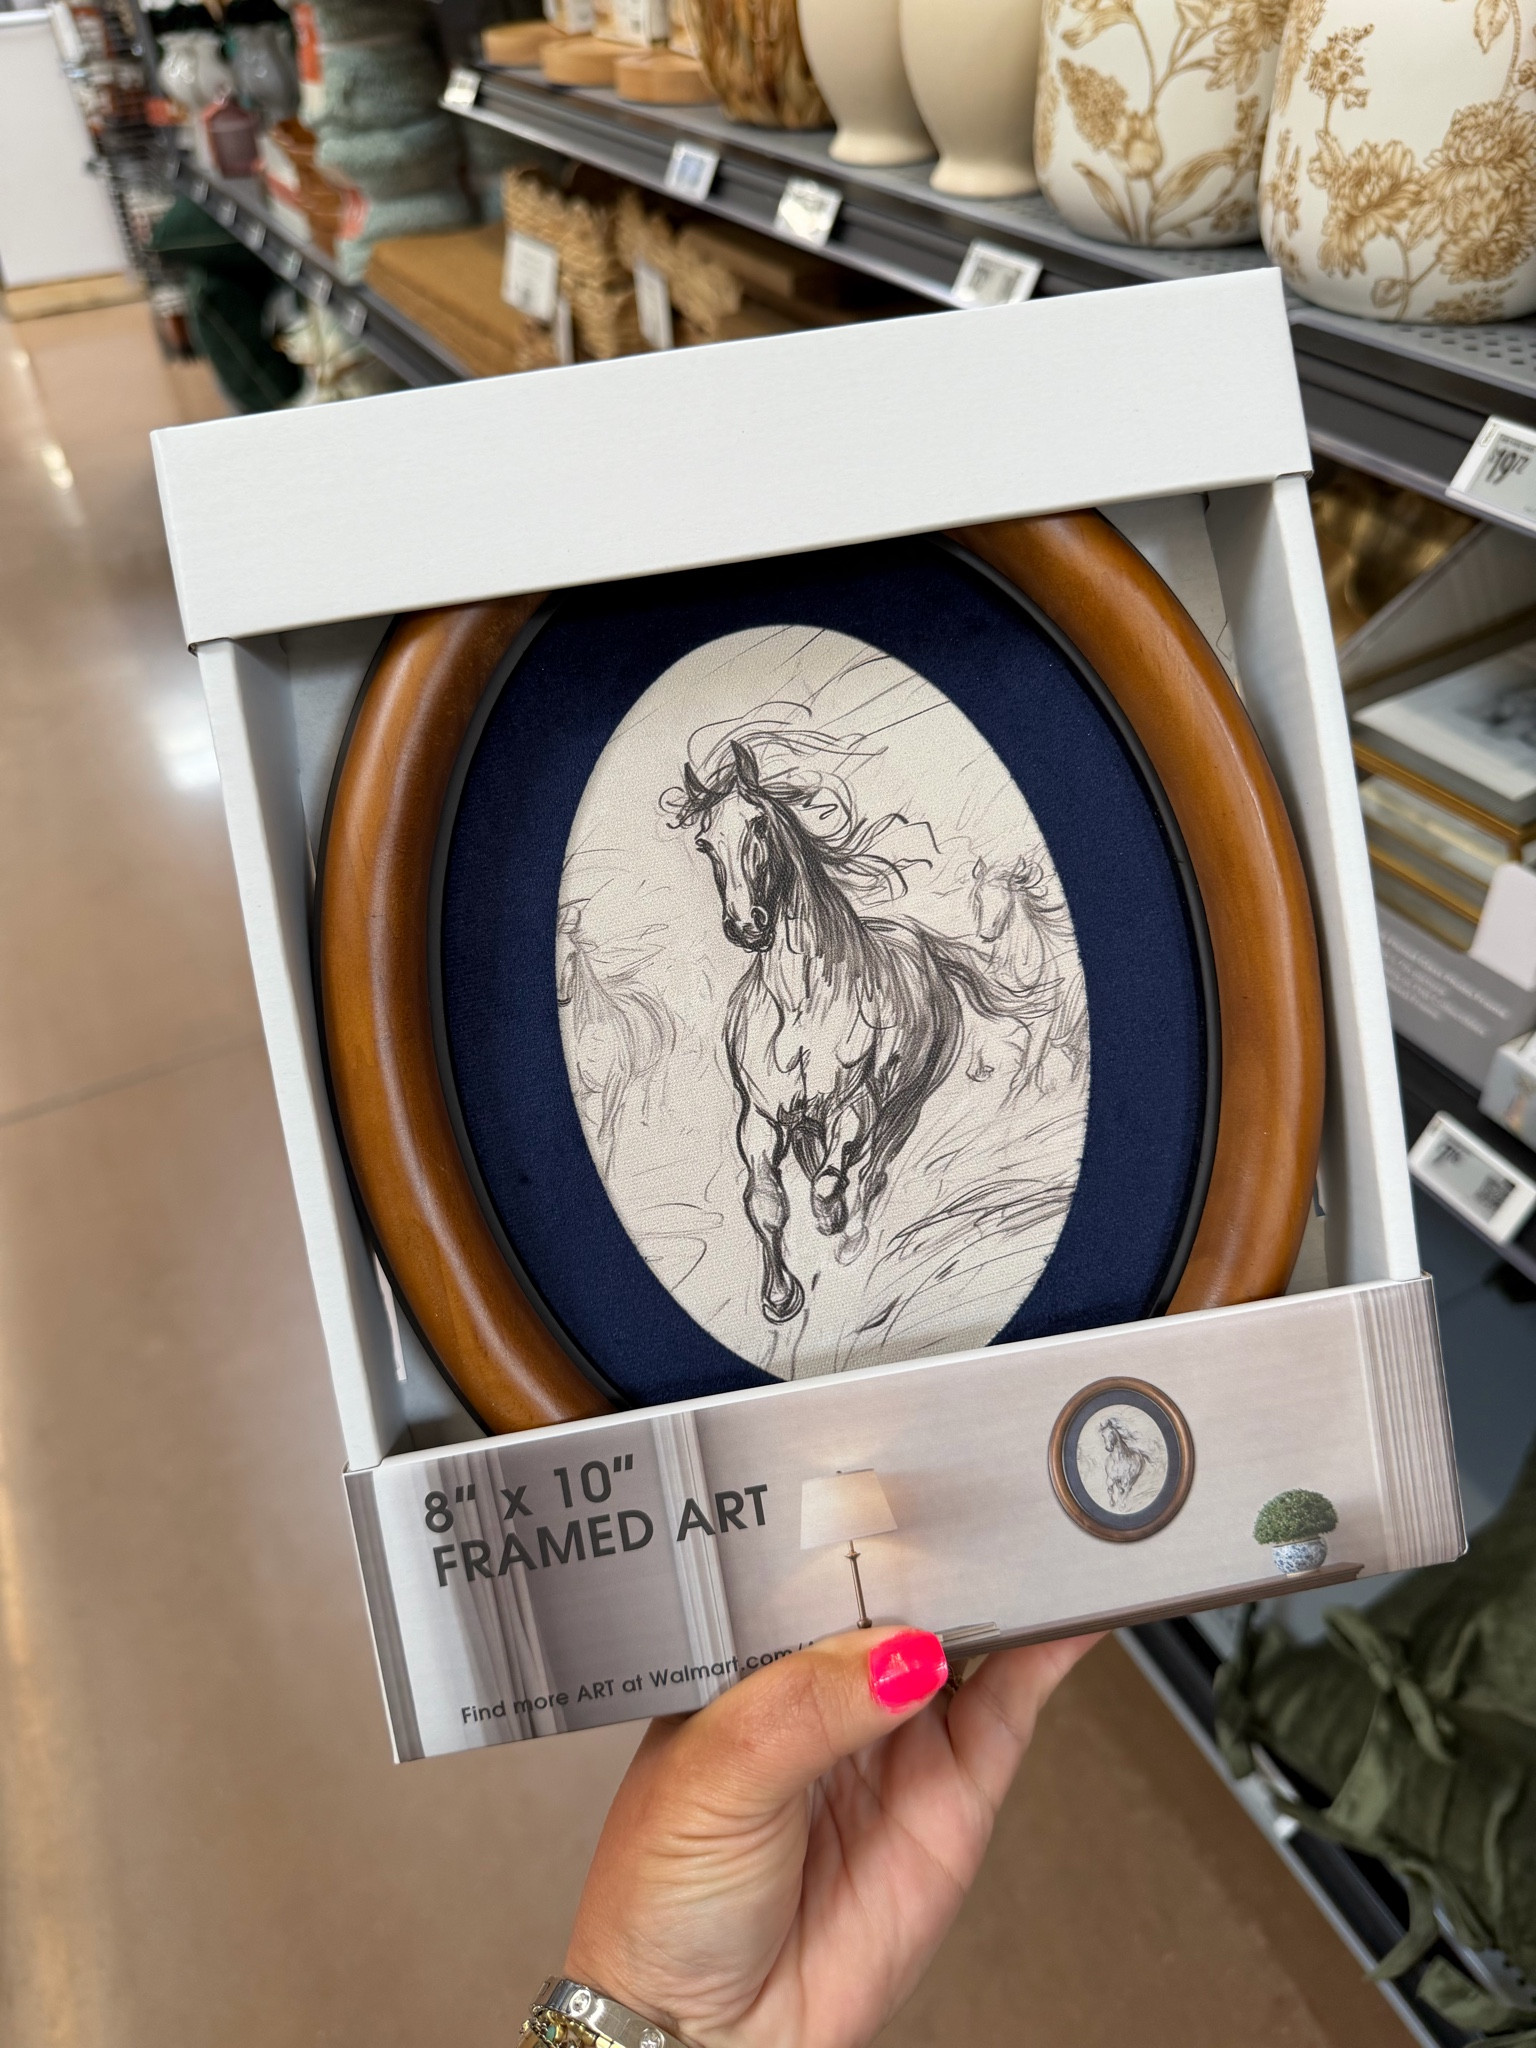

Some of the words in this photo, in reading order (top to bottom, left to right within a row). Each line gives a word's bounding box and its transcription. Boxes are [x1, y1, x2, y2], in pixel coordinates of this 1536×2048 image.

[425, 1483, 476, 1533] 8"
[500, 1485, 534, 1520] x
[553, 1453, 634, 1508] 10"
[432, 1509, 654, 1587] FRAMED
[676, 1484, 768, 1542] ART
[461, 1700, 507, 1724] Find
[513, 1691, 569, 1714] more
[577, 1679, 615, 1703] ART
[622, 1674, 643, 1693] at
